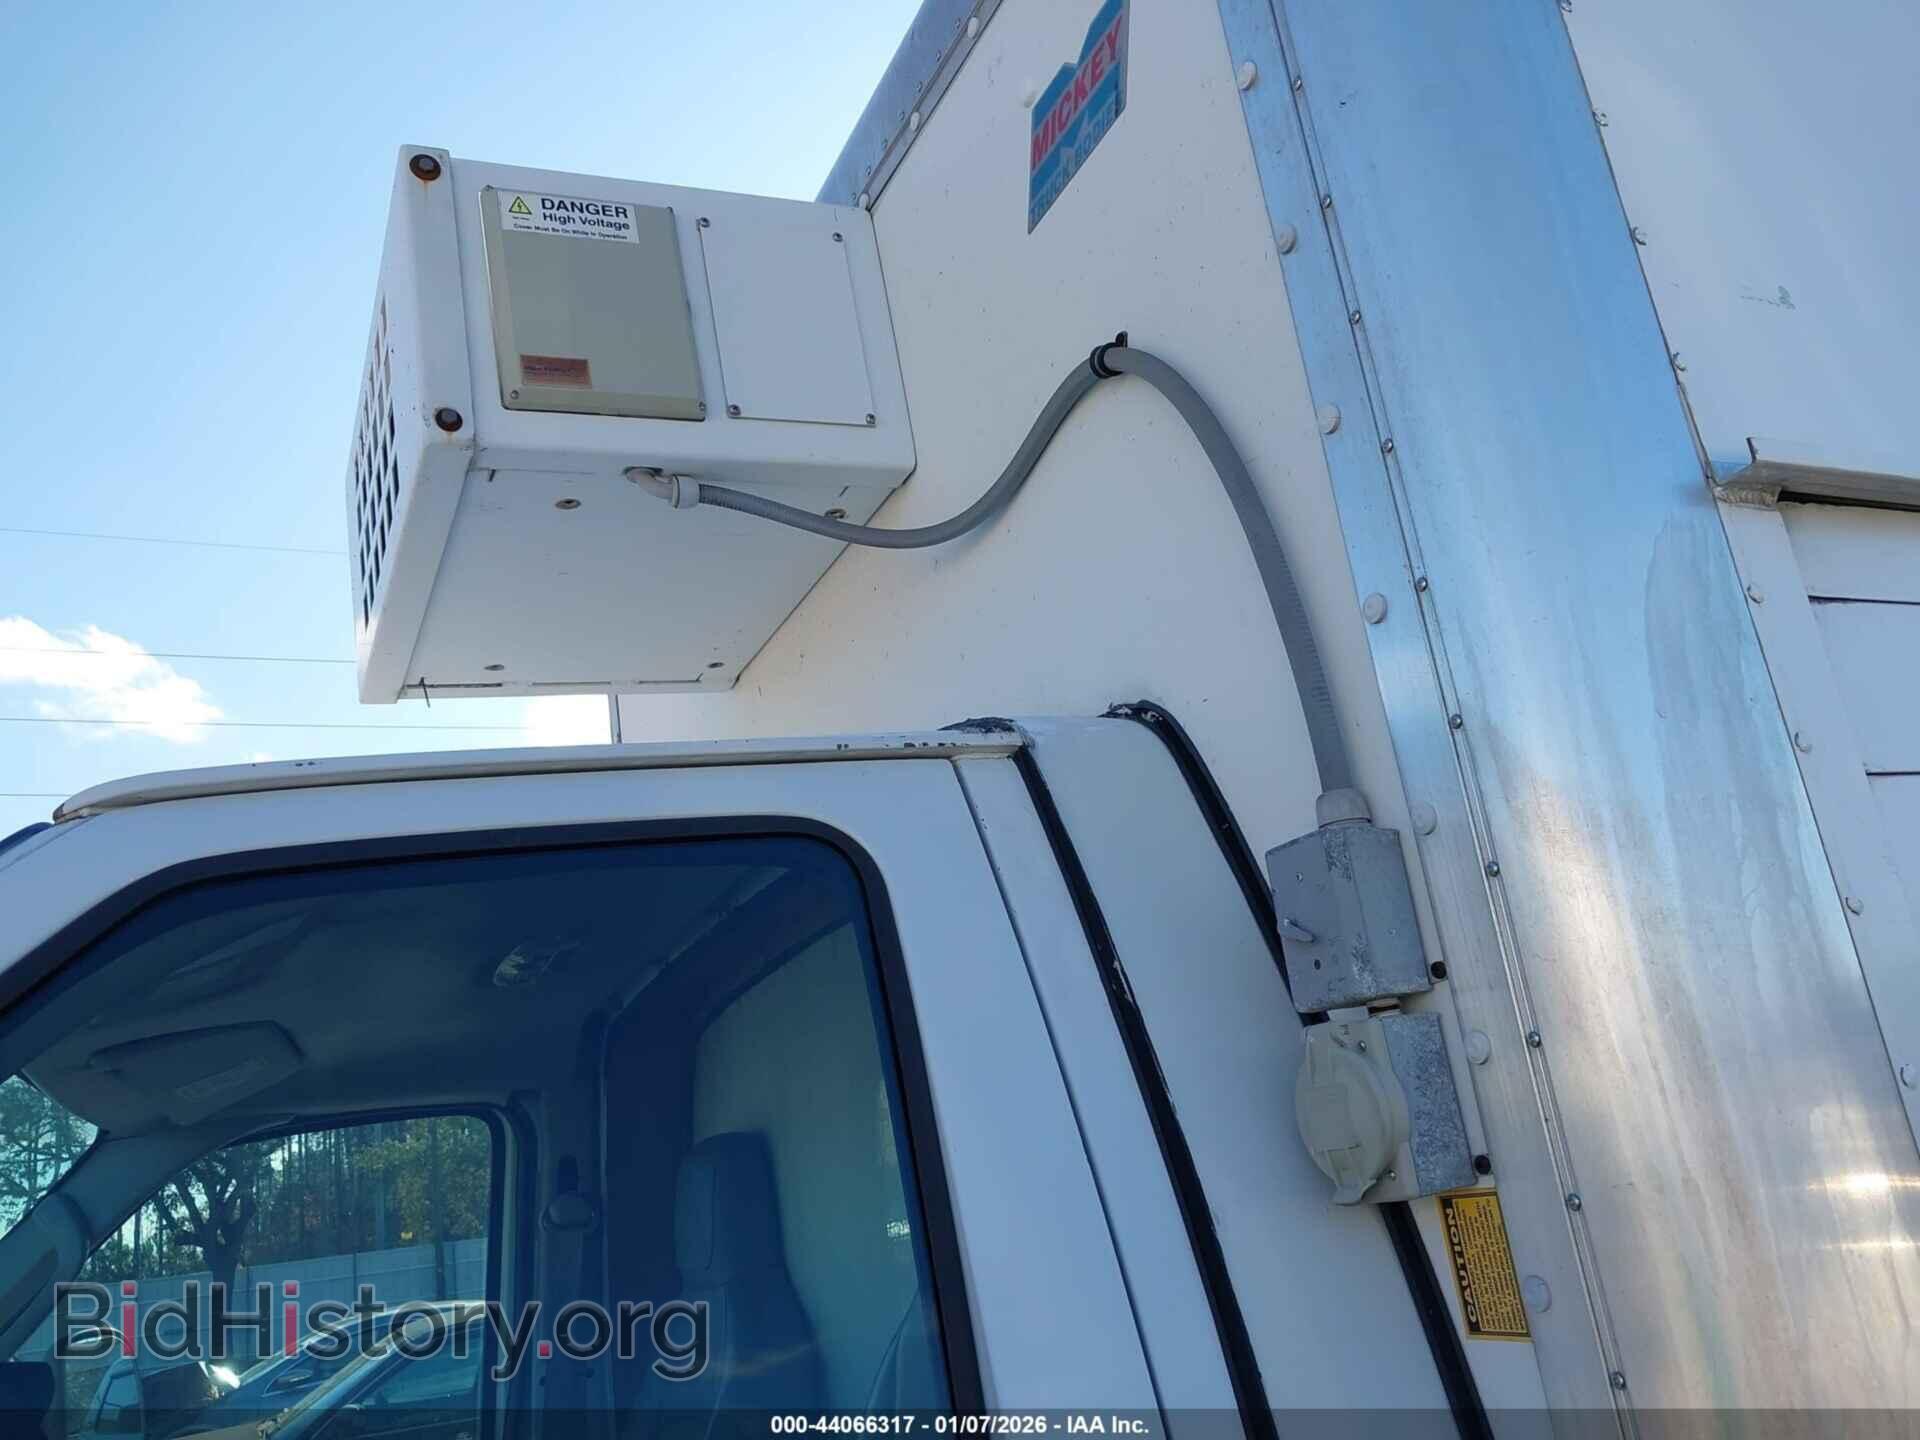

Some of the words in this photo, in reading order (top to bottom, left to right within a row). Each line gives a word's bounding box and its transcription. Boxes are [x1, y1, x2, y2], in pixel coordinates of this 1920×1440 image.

[1031, 14, 1122, 173] MICKEY
[541, 198, 629, 219] DANGER
[543, 212, 576, 226] High
[579, 215, 630, 231] Voltage
[1446, 1208, 1477, 1323] CAUTION
